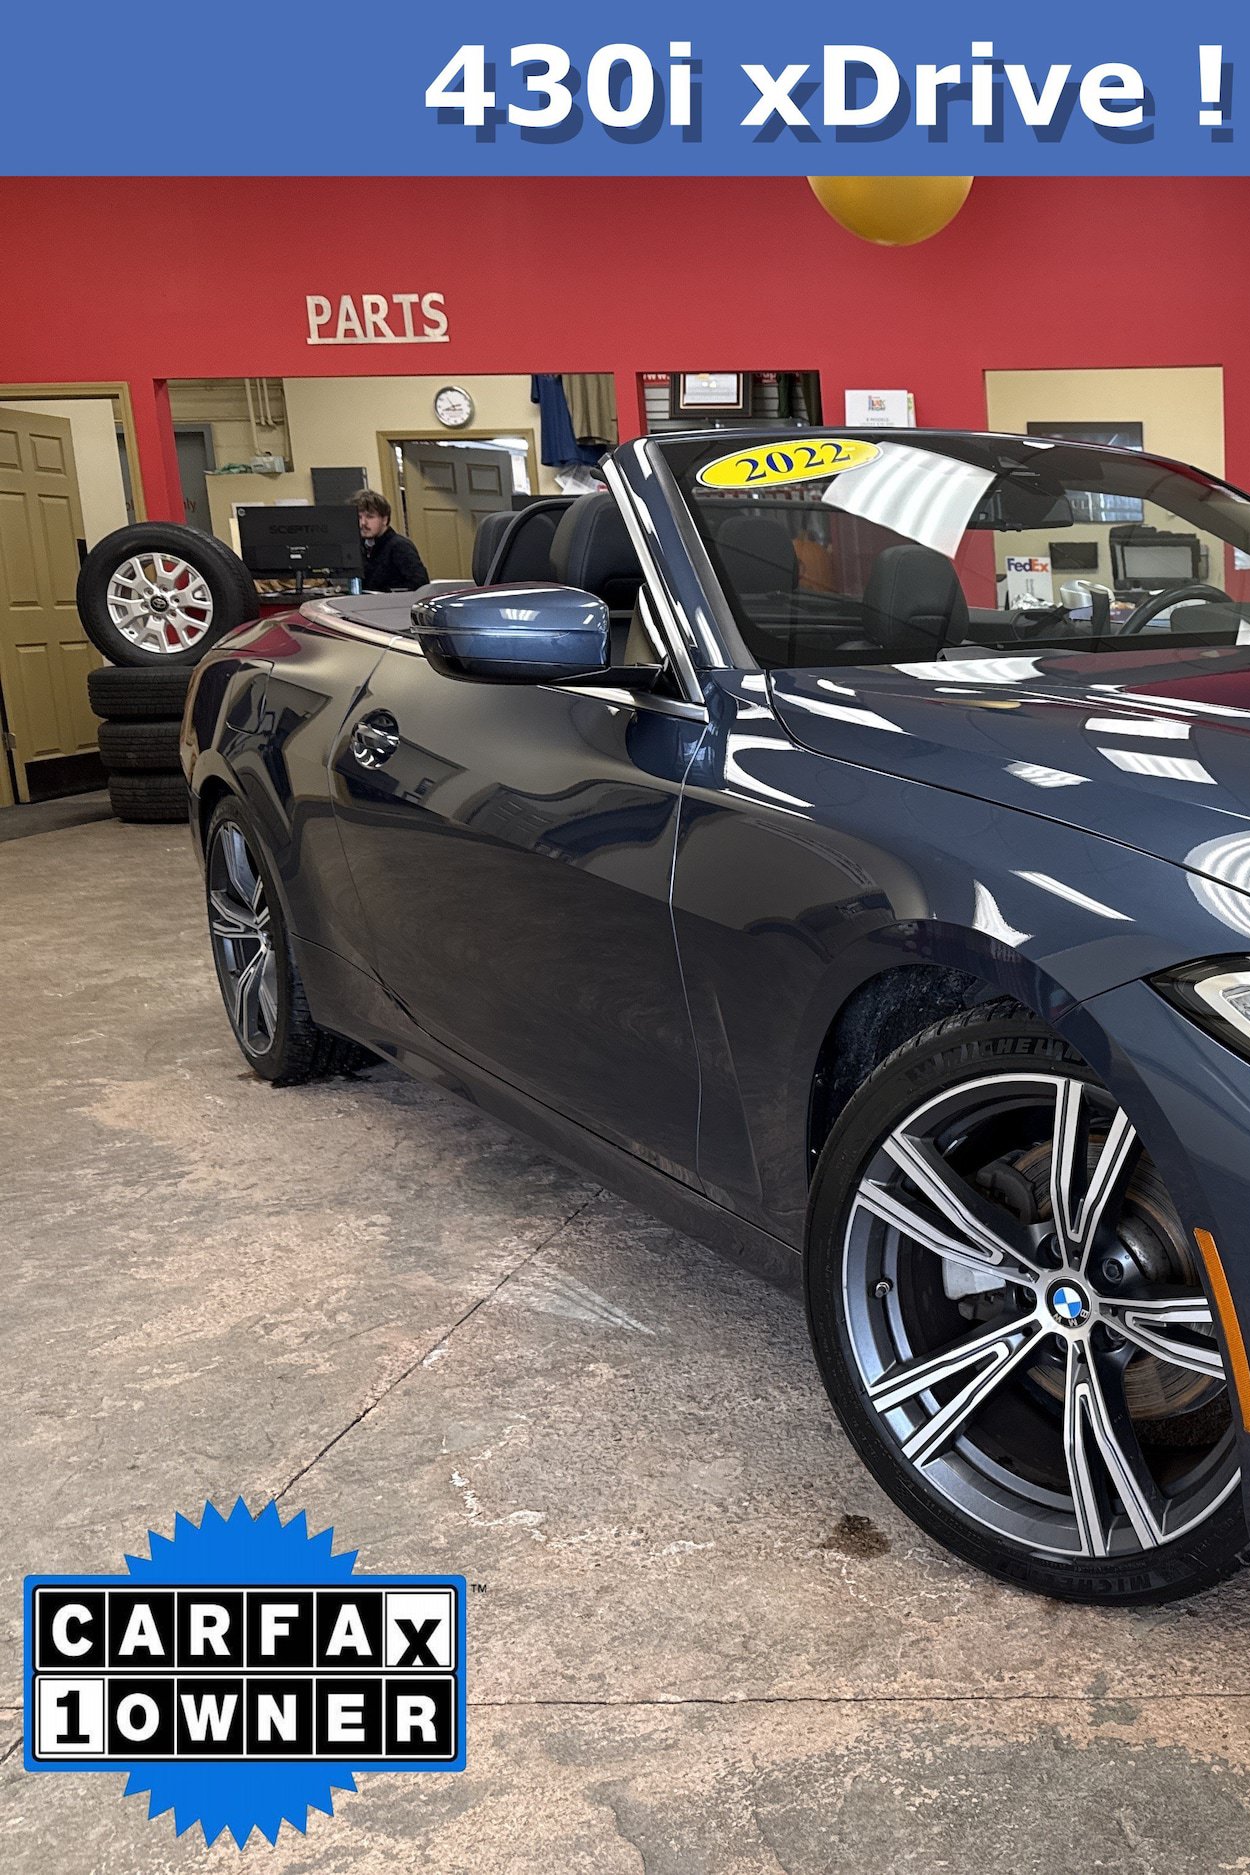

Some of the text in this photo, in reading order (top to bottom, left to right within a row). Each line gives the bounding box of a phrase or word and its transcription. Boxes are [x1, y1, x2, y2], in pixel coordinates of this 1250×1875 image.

[305, 292, 449, 341] PARTS
[735, 442, 851, 482] 2022
[1007, 557, 1049, 573] FedEx
